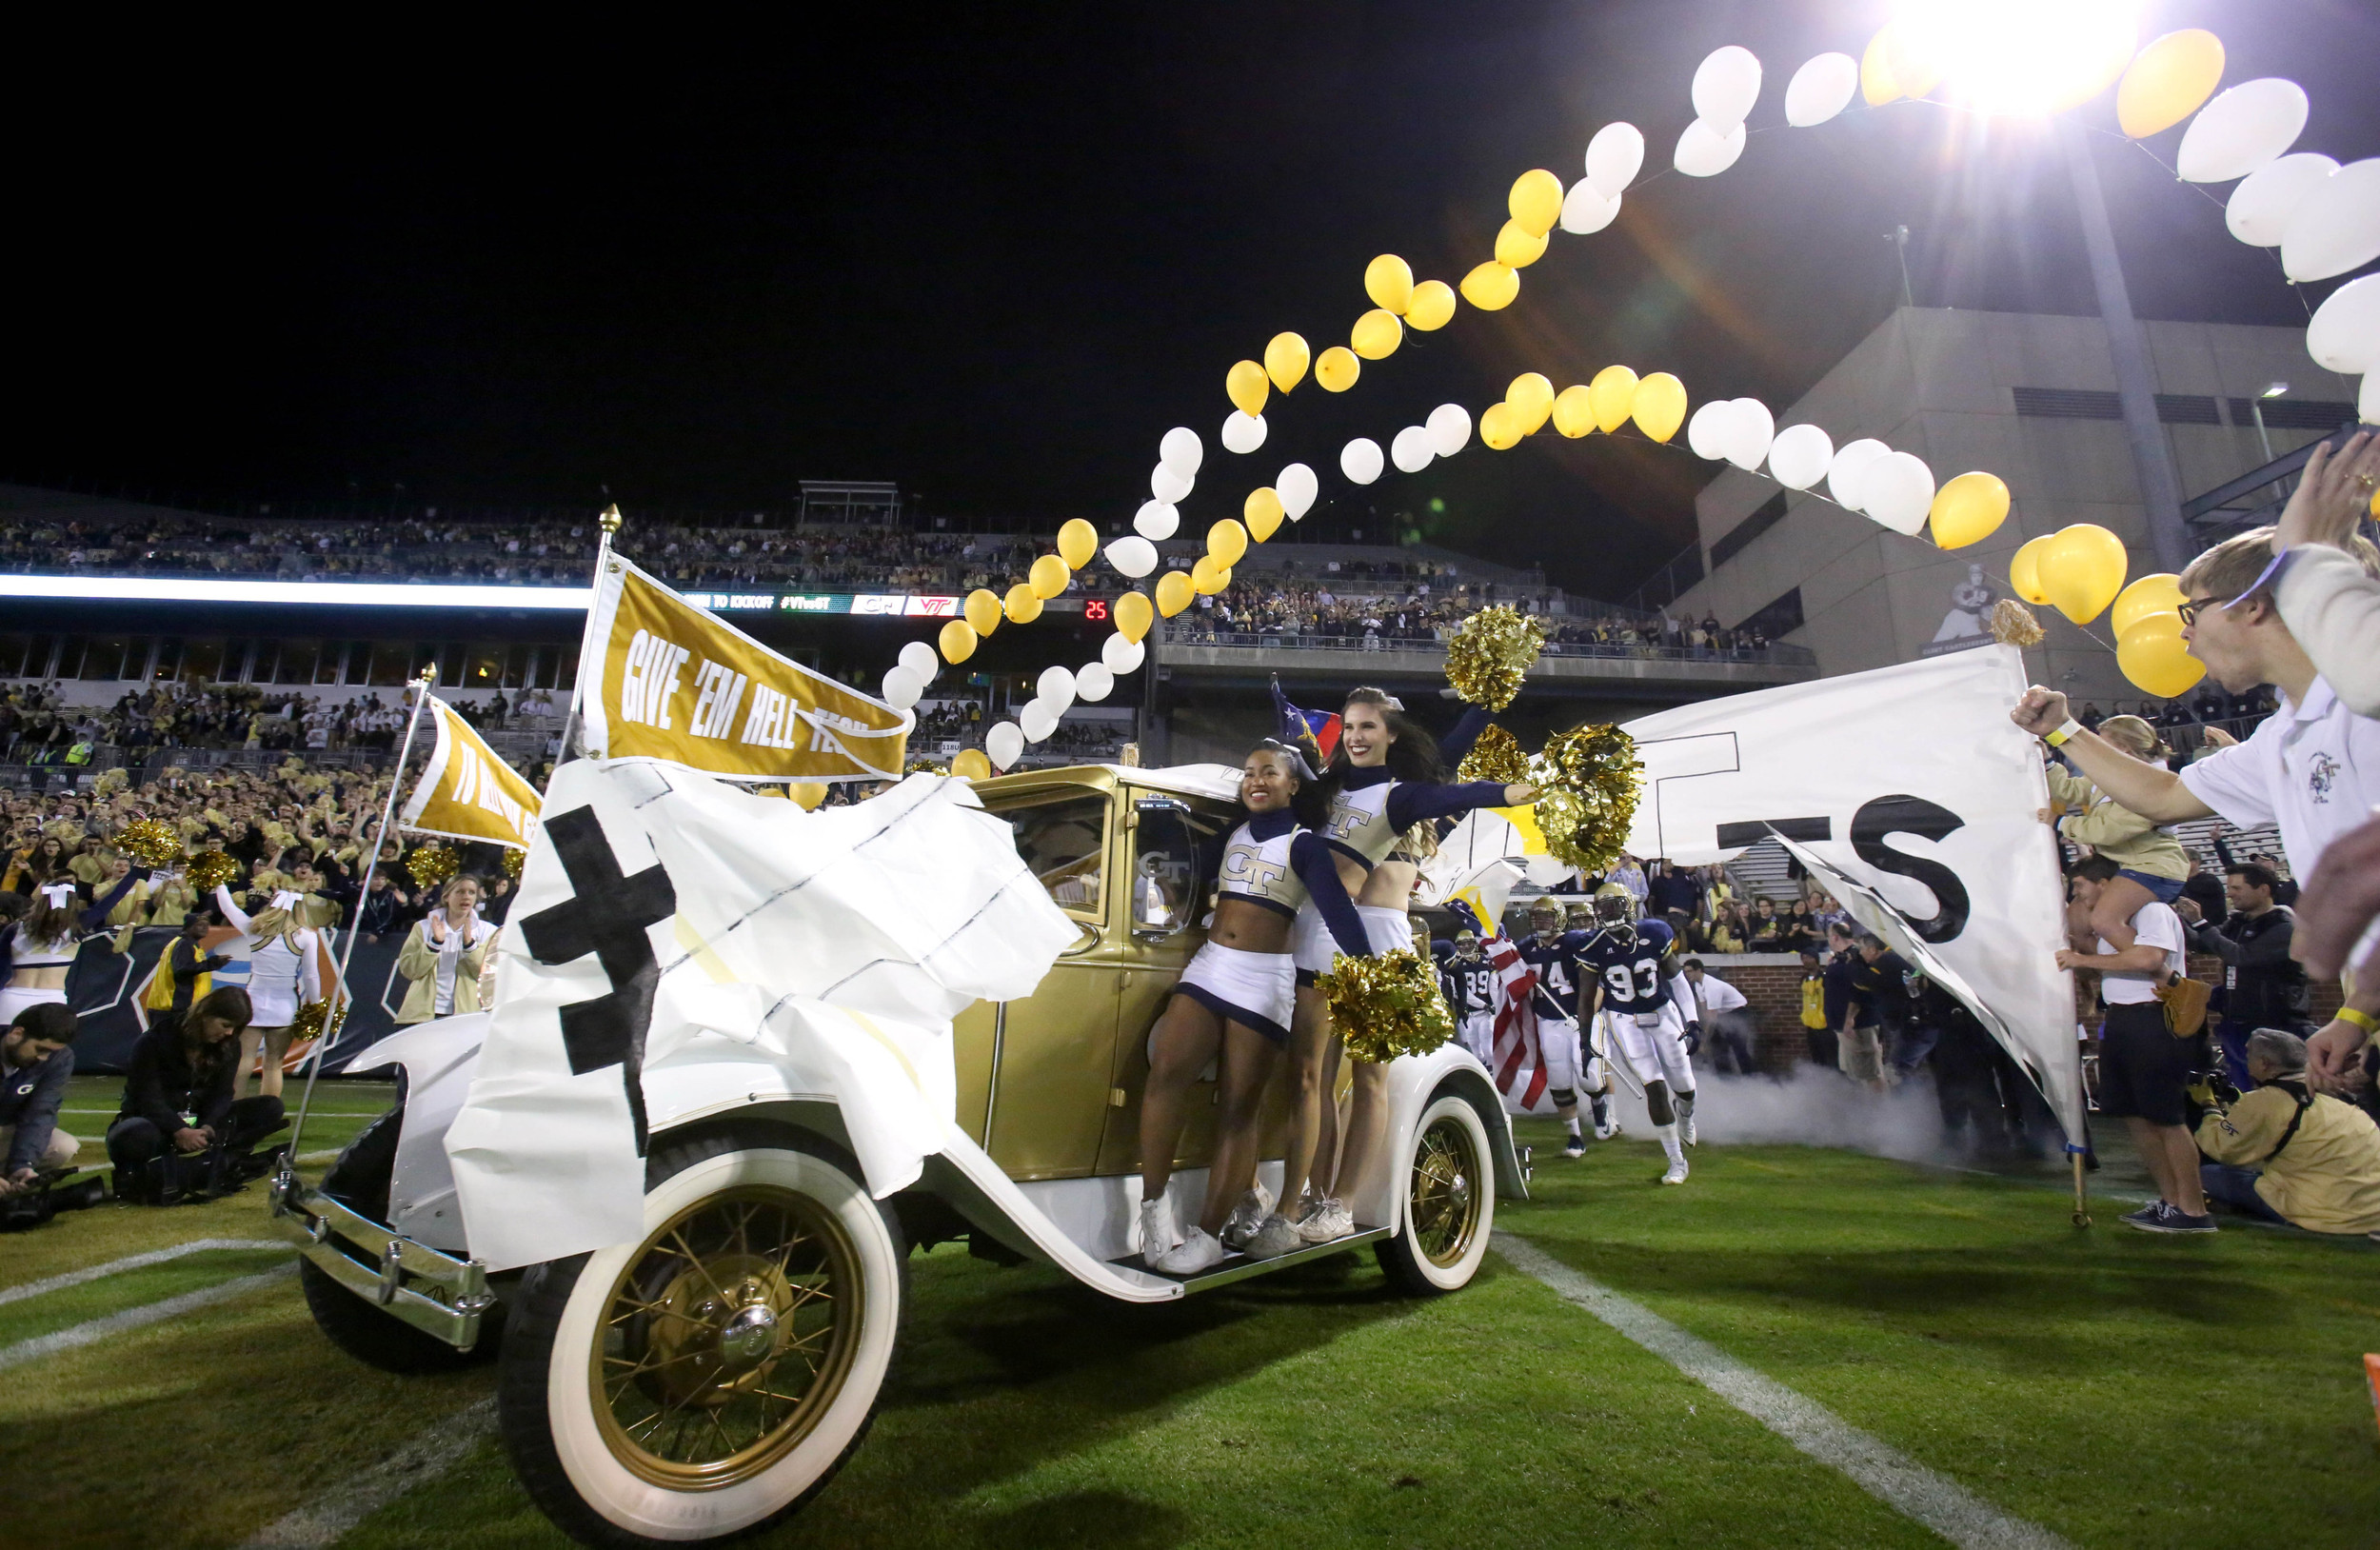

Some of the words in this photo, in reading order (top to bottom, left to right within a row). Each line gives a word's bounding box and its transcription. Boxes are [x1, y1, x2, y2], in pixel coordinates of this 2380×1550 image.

[713, 594, 728, 607] TO
[730, 595, 775, 608] KICKOFF
[920, 597, 953, 615] VT
[1085, 601, 1106, 620] 25
[621, 628, 691, 730] GIVE
[689, 658, 748, 741] 'EM
[741, 682, 799, 750] HELL
[451, 740, 477, 805] TO
[1138, 850, 1190, 884] GT
[1220, 844, 1287, 896] GT
[1463, 969, 1491, 995] 89
[1605, 957, 1658, 1003] 93
[2219, 1118, 2240, 1138] GT
